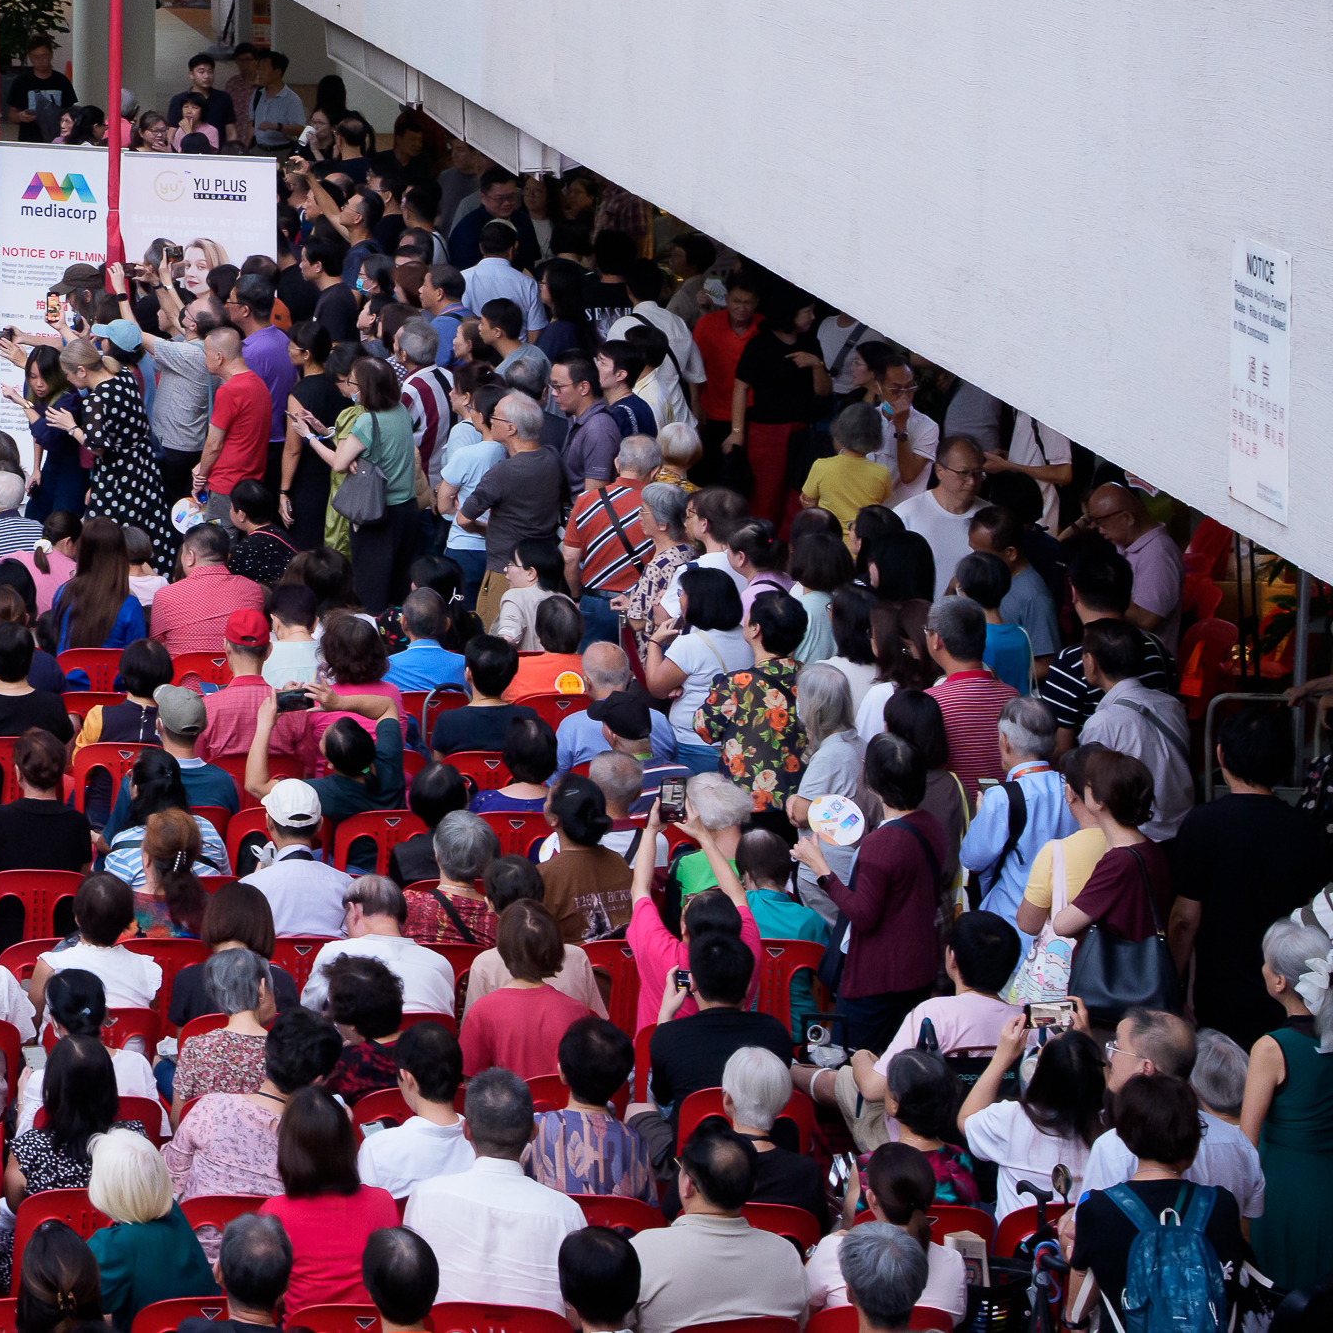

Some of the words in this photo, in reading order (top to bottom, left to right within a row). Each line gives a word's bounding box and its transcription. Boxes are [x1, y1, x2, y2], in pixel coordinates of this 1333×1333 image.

[193, 177, 210, 191] YU
[215, 179, 247, 193] PLUS
[194, 193, 247, 201] SINGAPORE
[20, 204, 97, 223] mediacorp
[132, 214, 169, 224] SALON
[173, 216, 213, 226] RESULT
[219, 218, 232, 227] AT
[141, 227, 170, 237] WITH
[2, 246, 46, 259] NOTICE
[49, 250, 65, 259] OF
[69, 251, 106, 263] FILMIN
[1246, 252, 1275, 285] NOTICE
